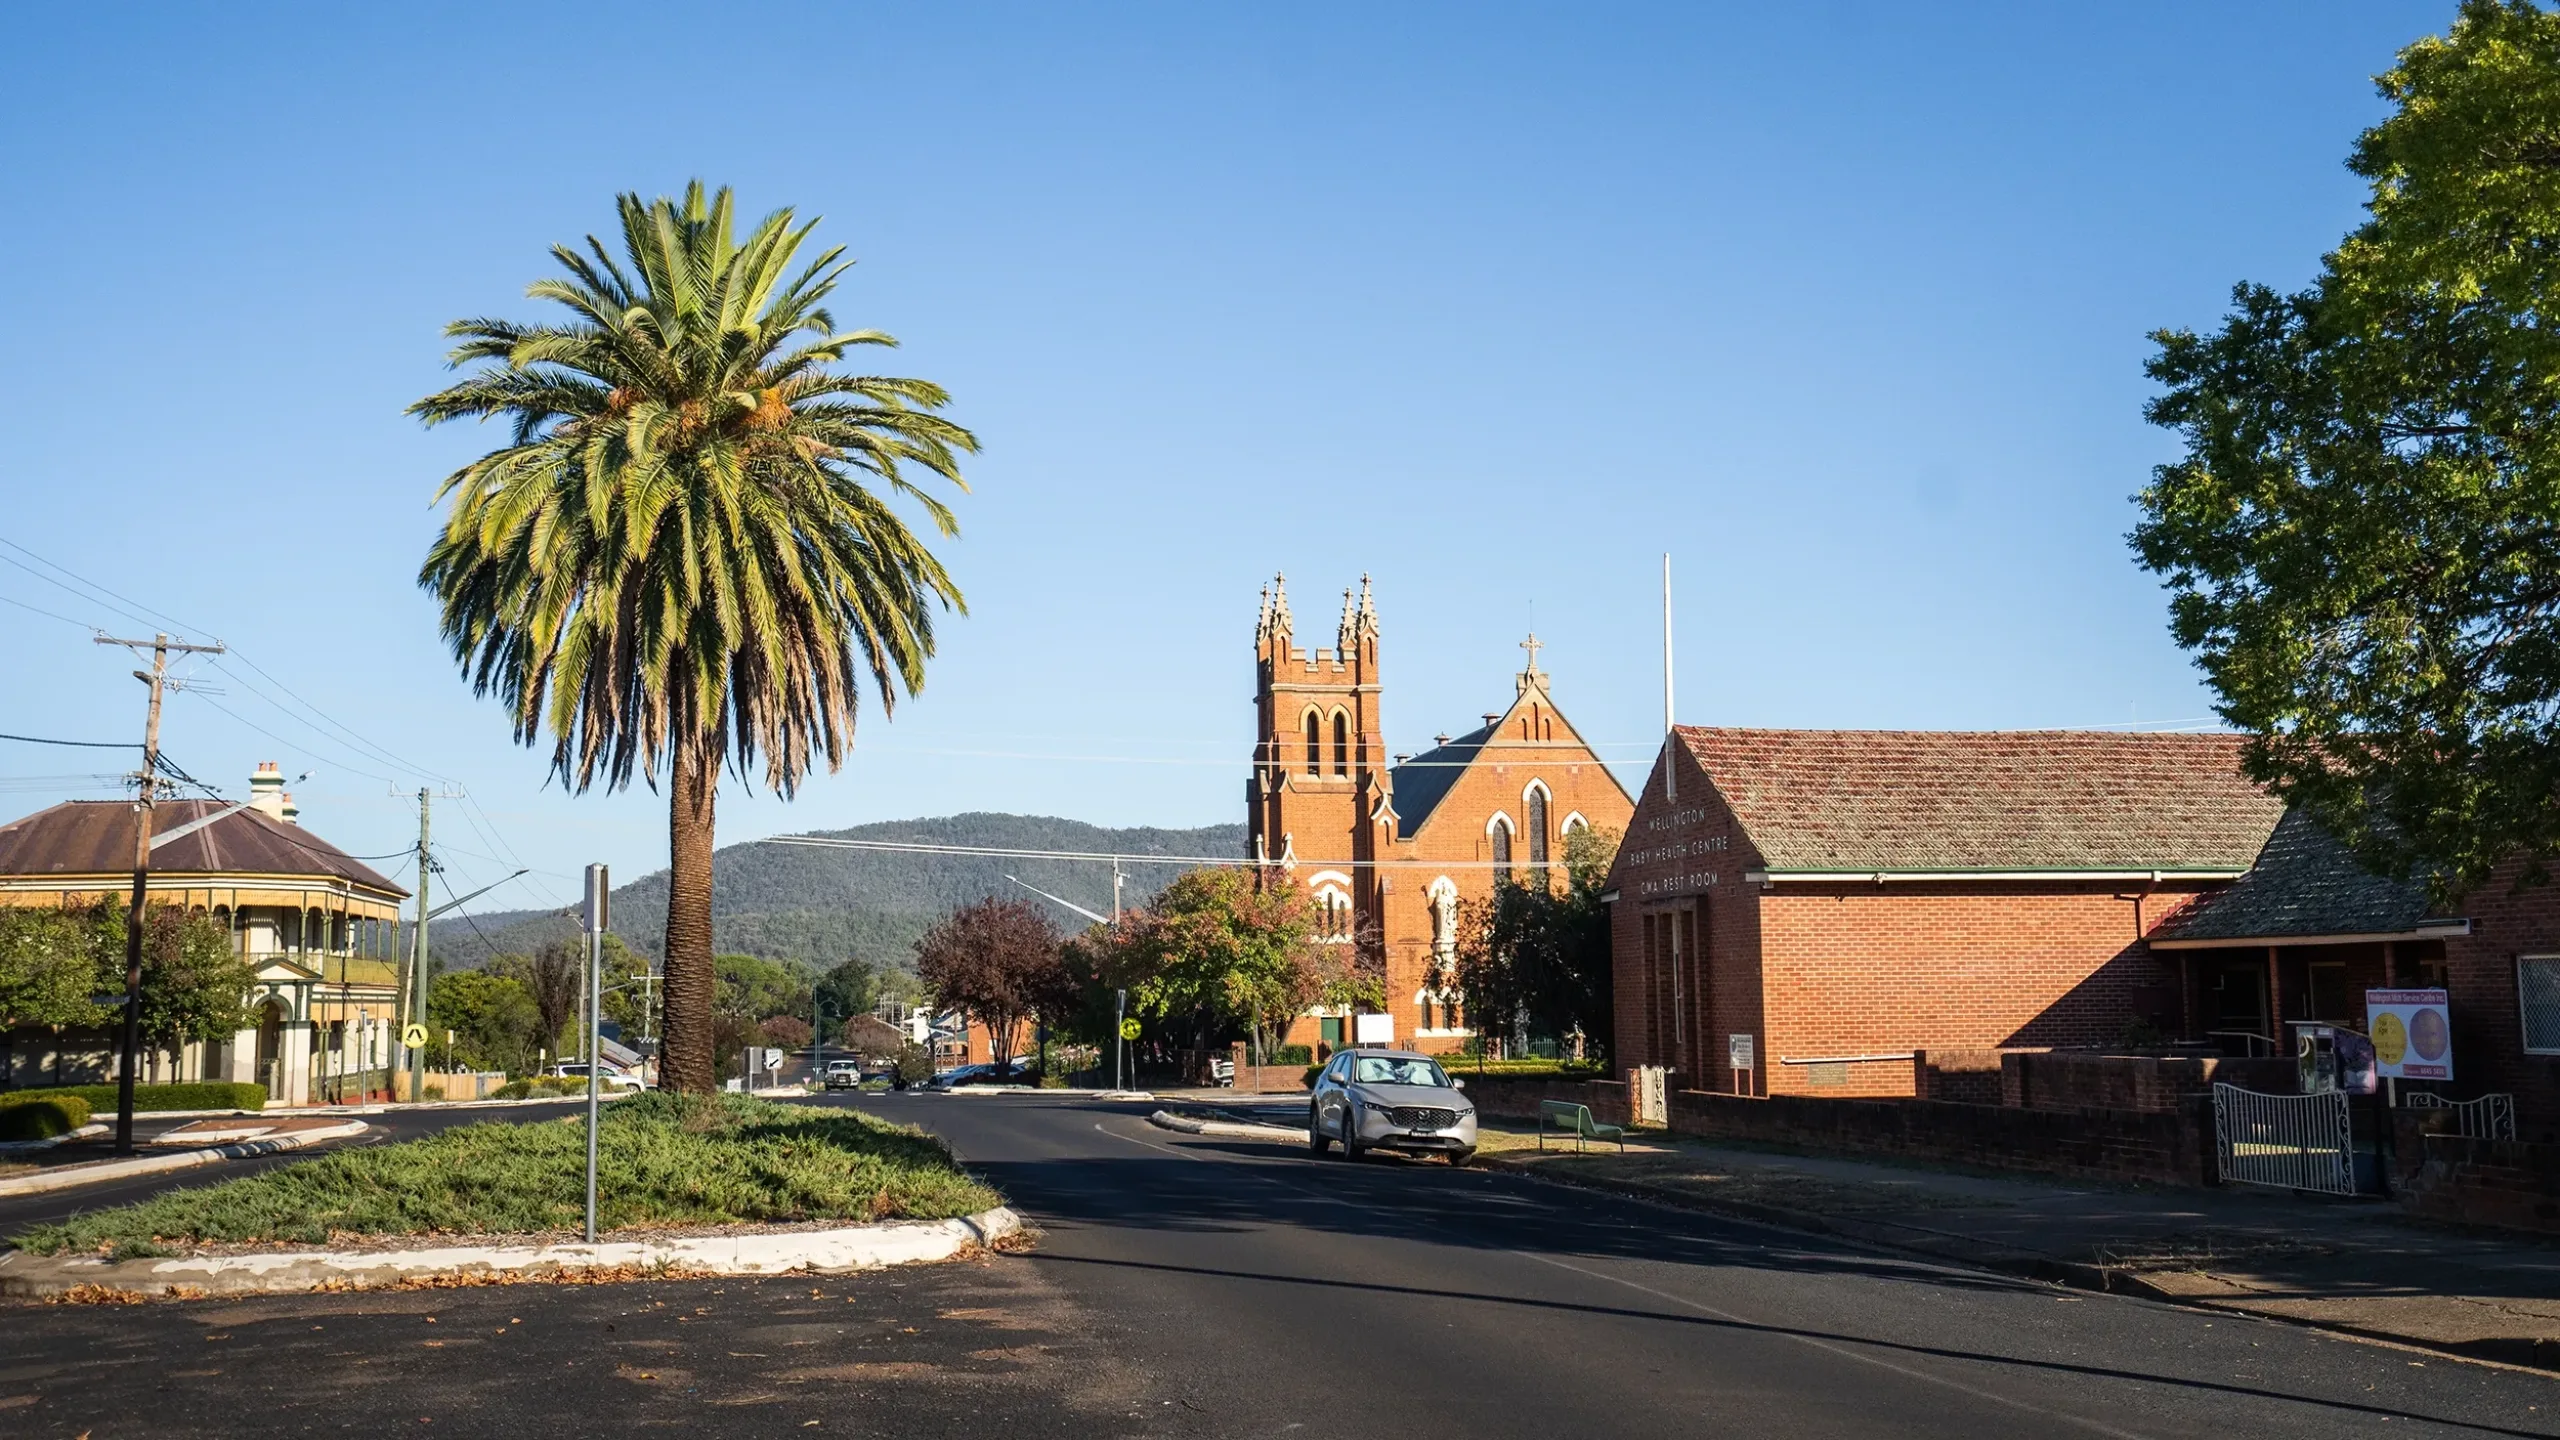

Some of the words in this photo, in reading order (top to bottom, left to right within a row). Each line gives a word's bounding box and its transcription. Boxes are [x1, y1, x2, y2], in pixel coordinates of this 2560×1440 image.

[1649, 808, 1705, 831] WELLINGTON
[1630, 851, 1651, 866] BABY
[1655, 844, 1687, 861] HEALTH
[1692, 836, 1728, 854] CENTRE
[1641, 880, 1658, 895] CWA
[1664, 876, 1684, 891] REST
[1690, 872, 1718, 888] ROOM
